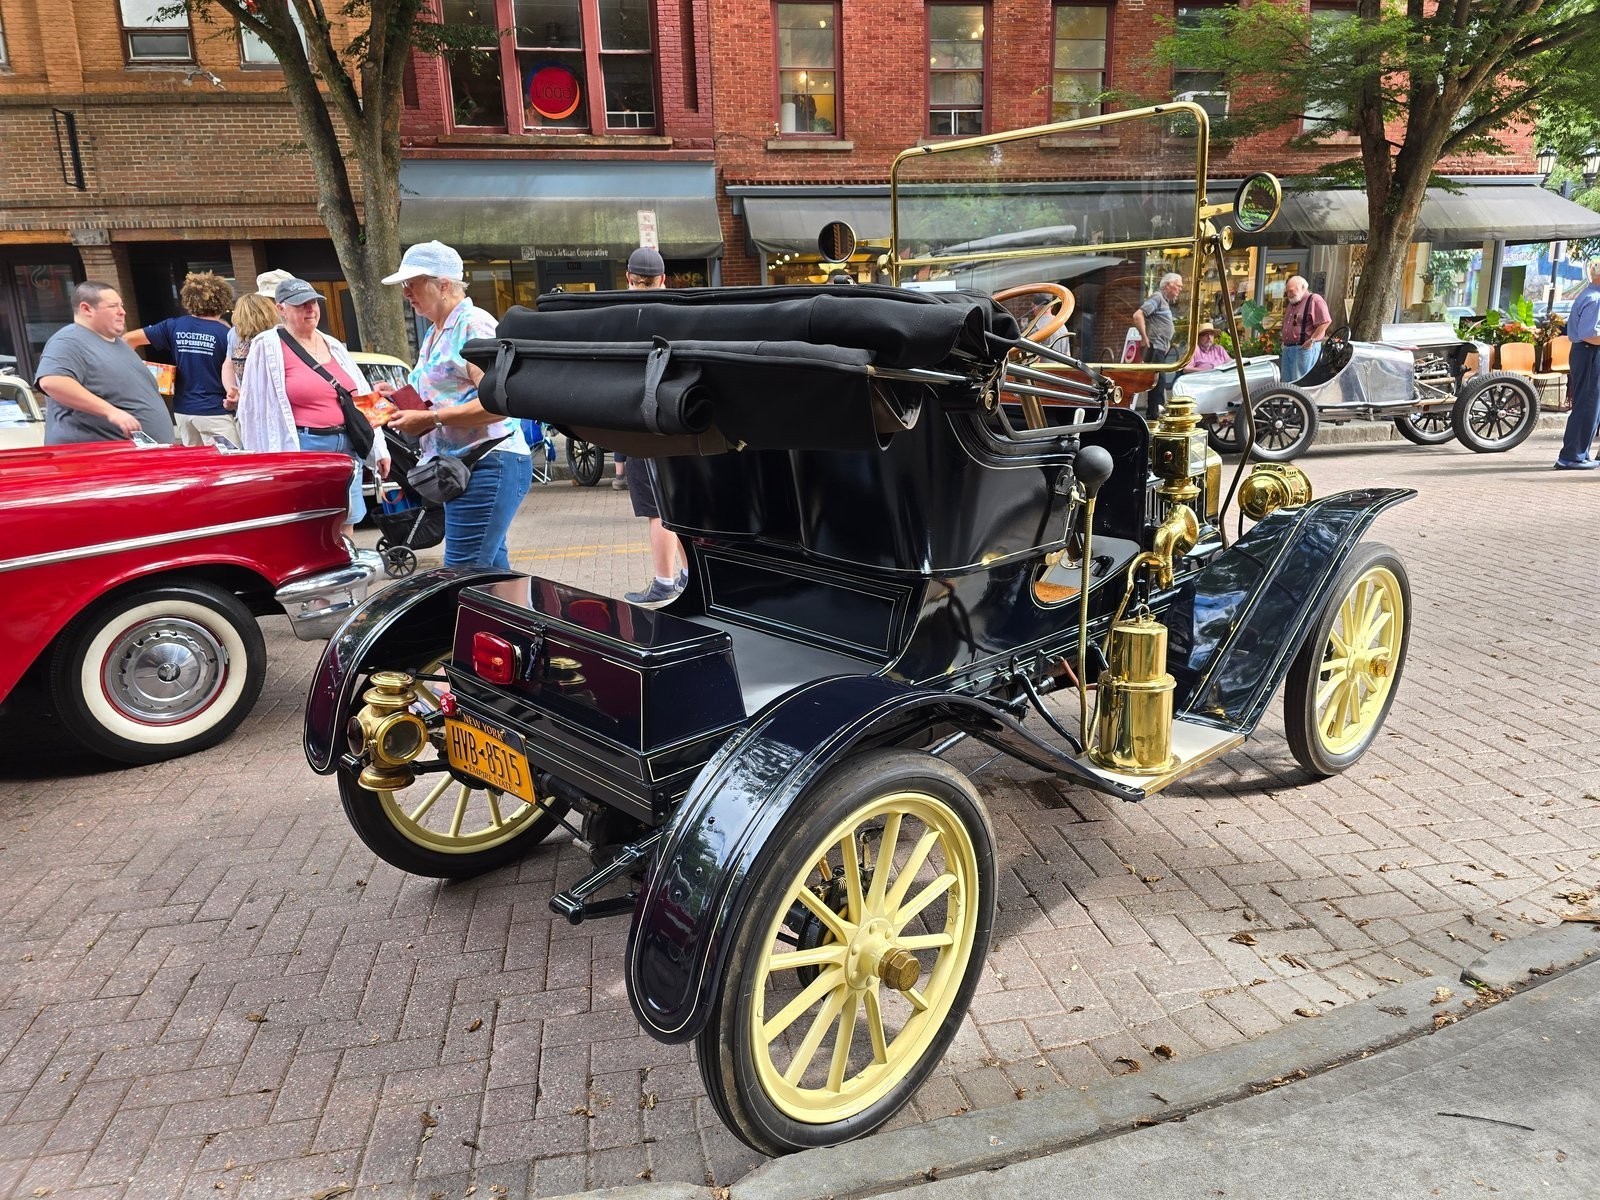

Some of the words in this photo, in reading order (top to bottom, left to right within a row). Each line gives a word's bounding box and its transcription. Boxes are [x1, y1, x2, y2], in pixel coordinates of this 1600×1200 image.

[577, 248, 608, 258] Cooperative
[463, 714, 481, 728] NEW
[482, 723, 504, 741] YORK
[469, 764, 492, 780] EMPIRE
[494, 777, 514, 790] STATE
